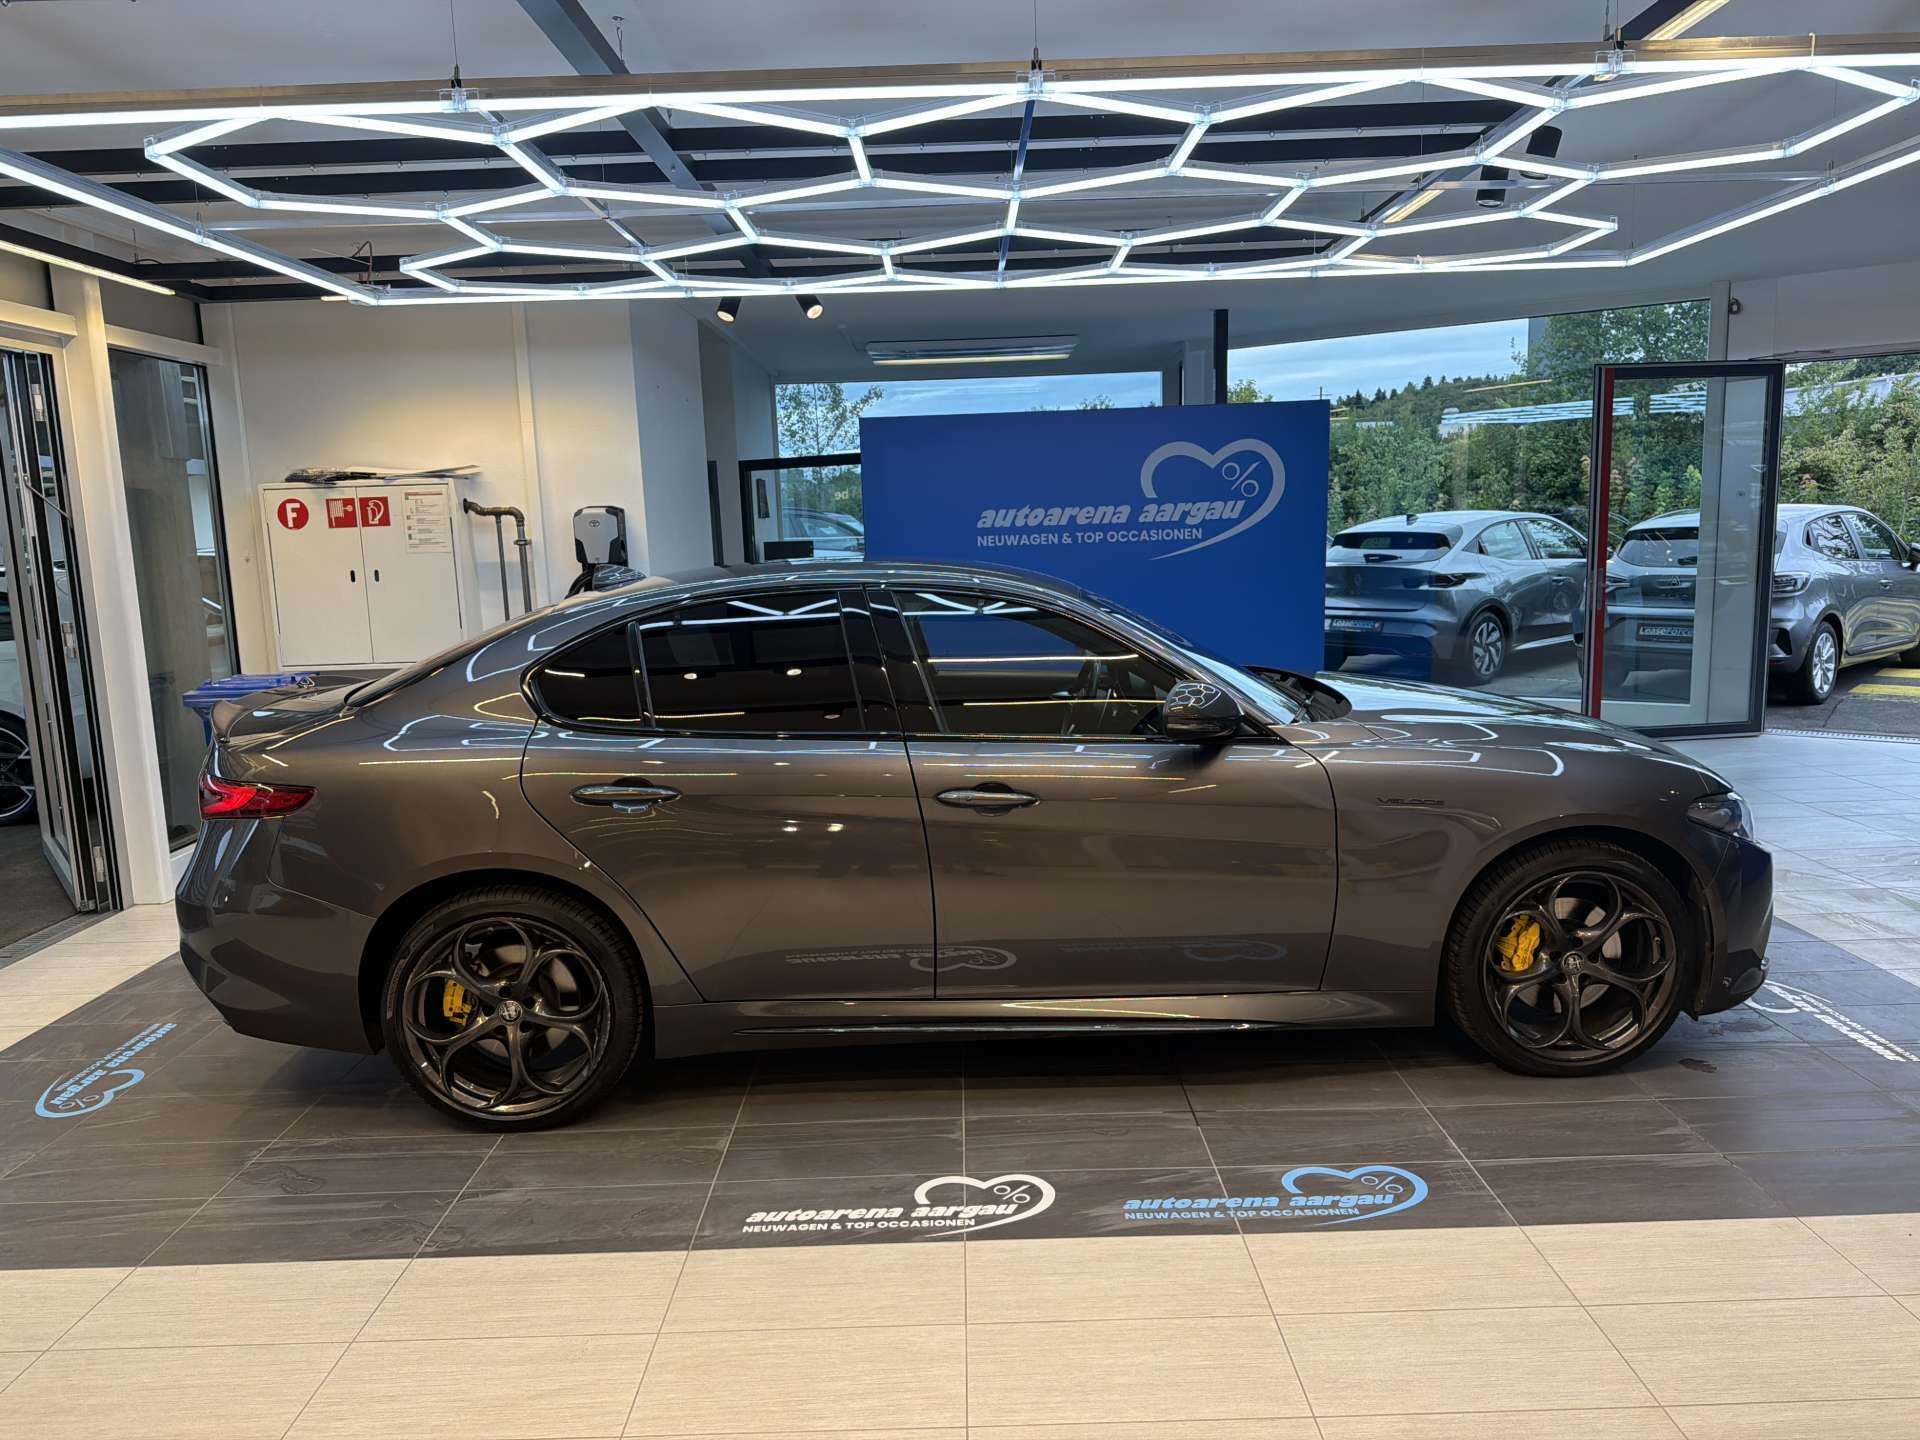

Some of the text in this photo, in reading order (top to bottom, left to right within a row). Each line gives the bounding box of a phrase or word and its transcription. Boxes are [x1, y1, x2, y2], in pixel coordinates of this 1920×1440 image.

[285, 502, 301, 528] F
[976, 499, 1247, 529] autoarena aargau
[976, 527, 1203, 547] NEUWAGEN & TOP OCCASIONEN
[1122, 1192, 1396, 1210] autoarena aargau
[745, 1203, 1019, 1222] autoarena aargau
[1123, 1207, 1361, 1221] NEUWAGEN & TOP OCCASIONEN
[741, 1218, 976, 1234] NEUWAGEN & TOP OCCASIONEN
